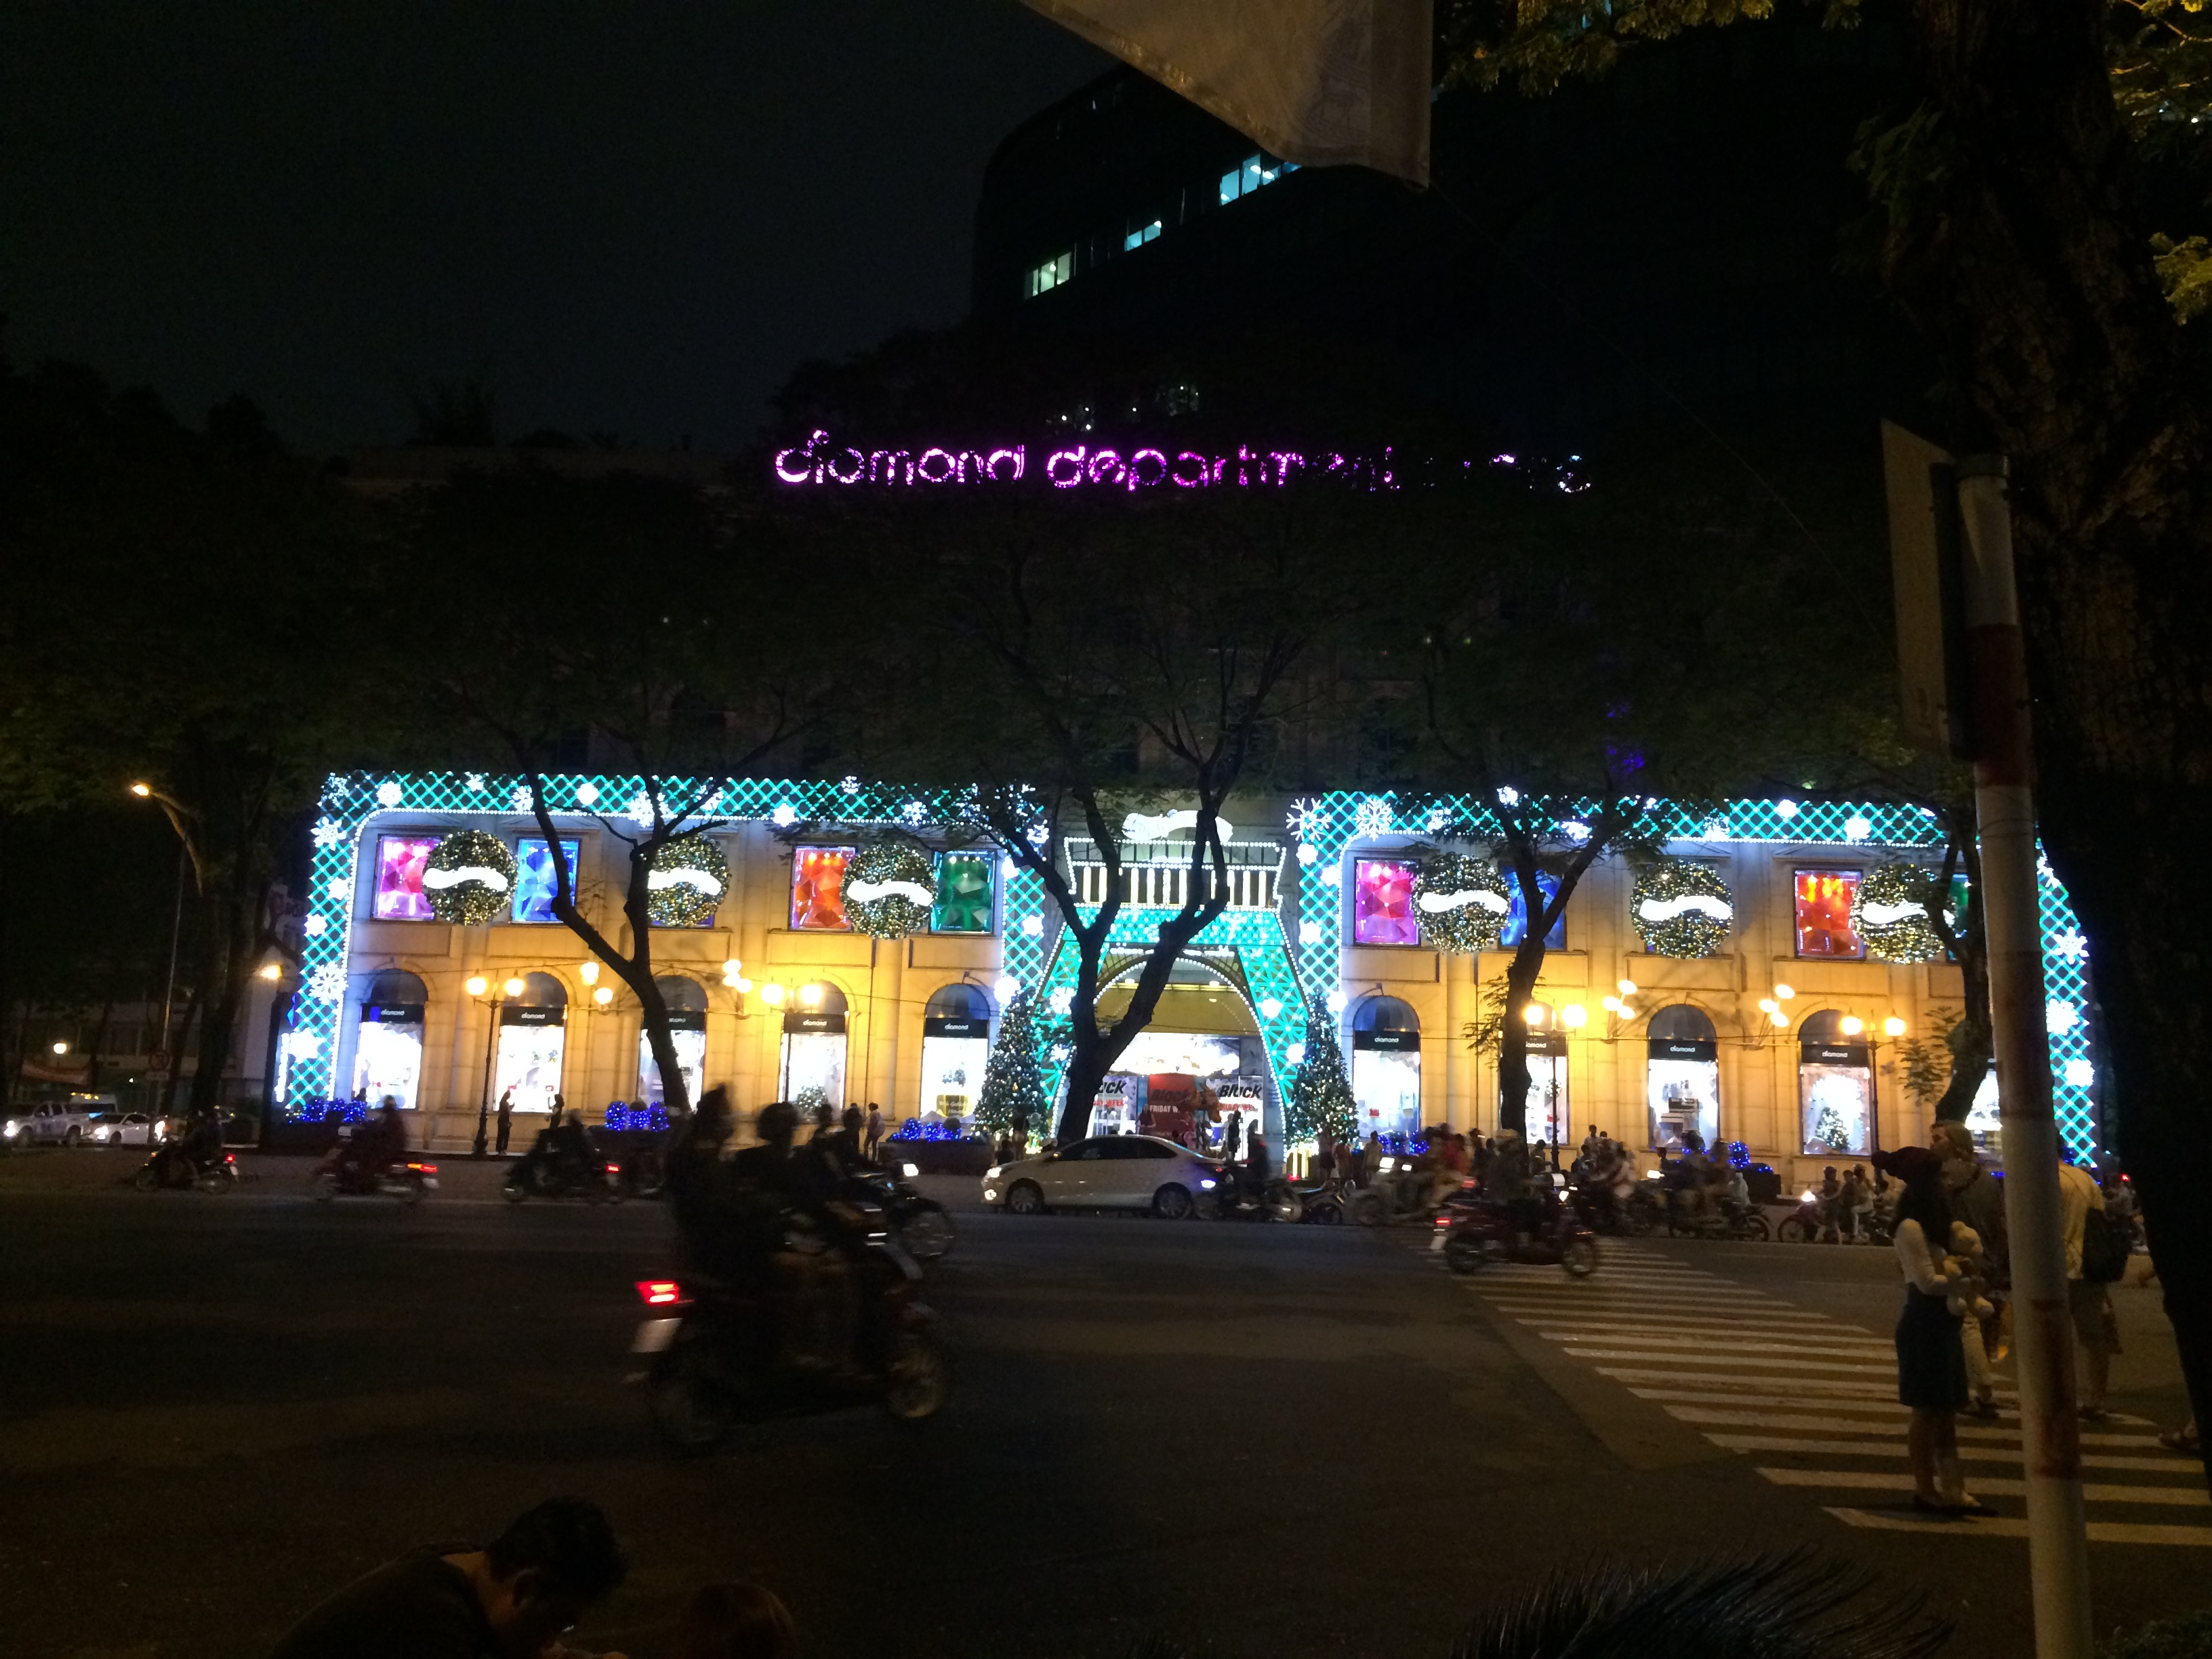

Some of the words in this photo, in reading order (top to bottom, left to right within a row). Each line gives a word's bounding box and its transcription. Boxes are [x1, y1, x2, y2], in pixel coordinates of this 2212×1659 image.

[775, 429, 1025, 485] diamond
[1046, 443, 1400, 492] departmt
[1374, 1035, 1399, 1043] diamond
[1822, 1050, 1848, 1058] diamond
[1149, 1104, 1172, 1113] FRIDAY
